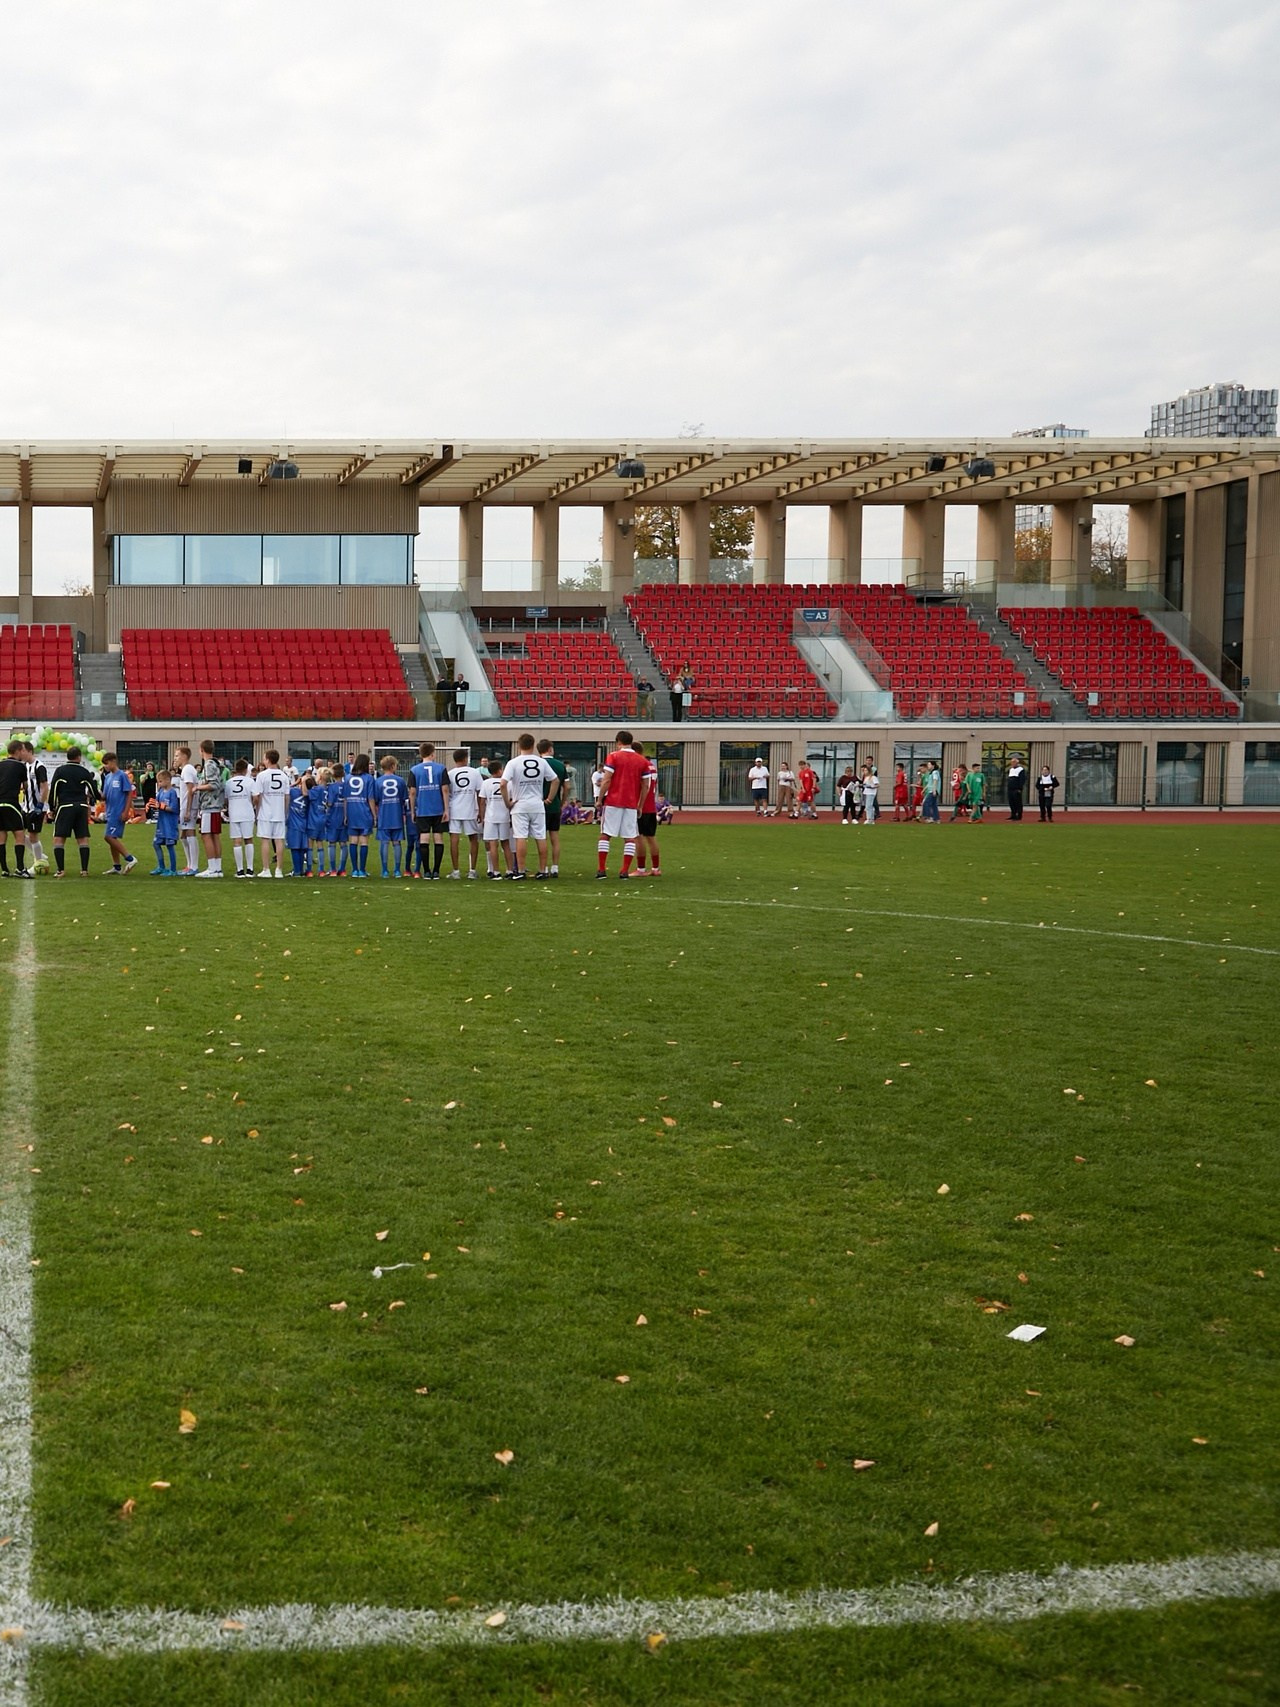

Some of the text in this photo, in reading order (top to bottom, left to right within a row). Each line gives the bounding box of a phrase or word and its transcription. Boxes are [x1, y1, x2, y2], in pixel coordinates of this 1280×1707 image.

[815, 612, 827, 620] A3
[423, 766, 433, 784] 1
[523, 759, 540, 778] 8
[232, 779, 244, 793] 3
[271, 774, 282, 790] 5
[349, 776, 364, 796] 9
[455, 771, 470, 788] 6
[382, 779, 398, 797] 8
[492, 782, 502, 795] 2
[293, 796, 306, 809] 4
[109, 826, 117, 835] 7
